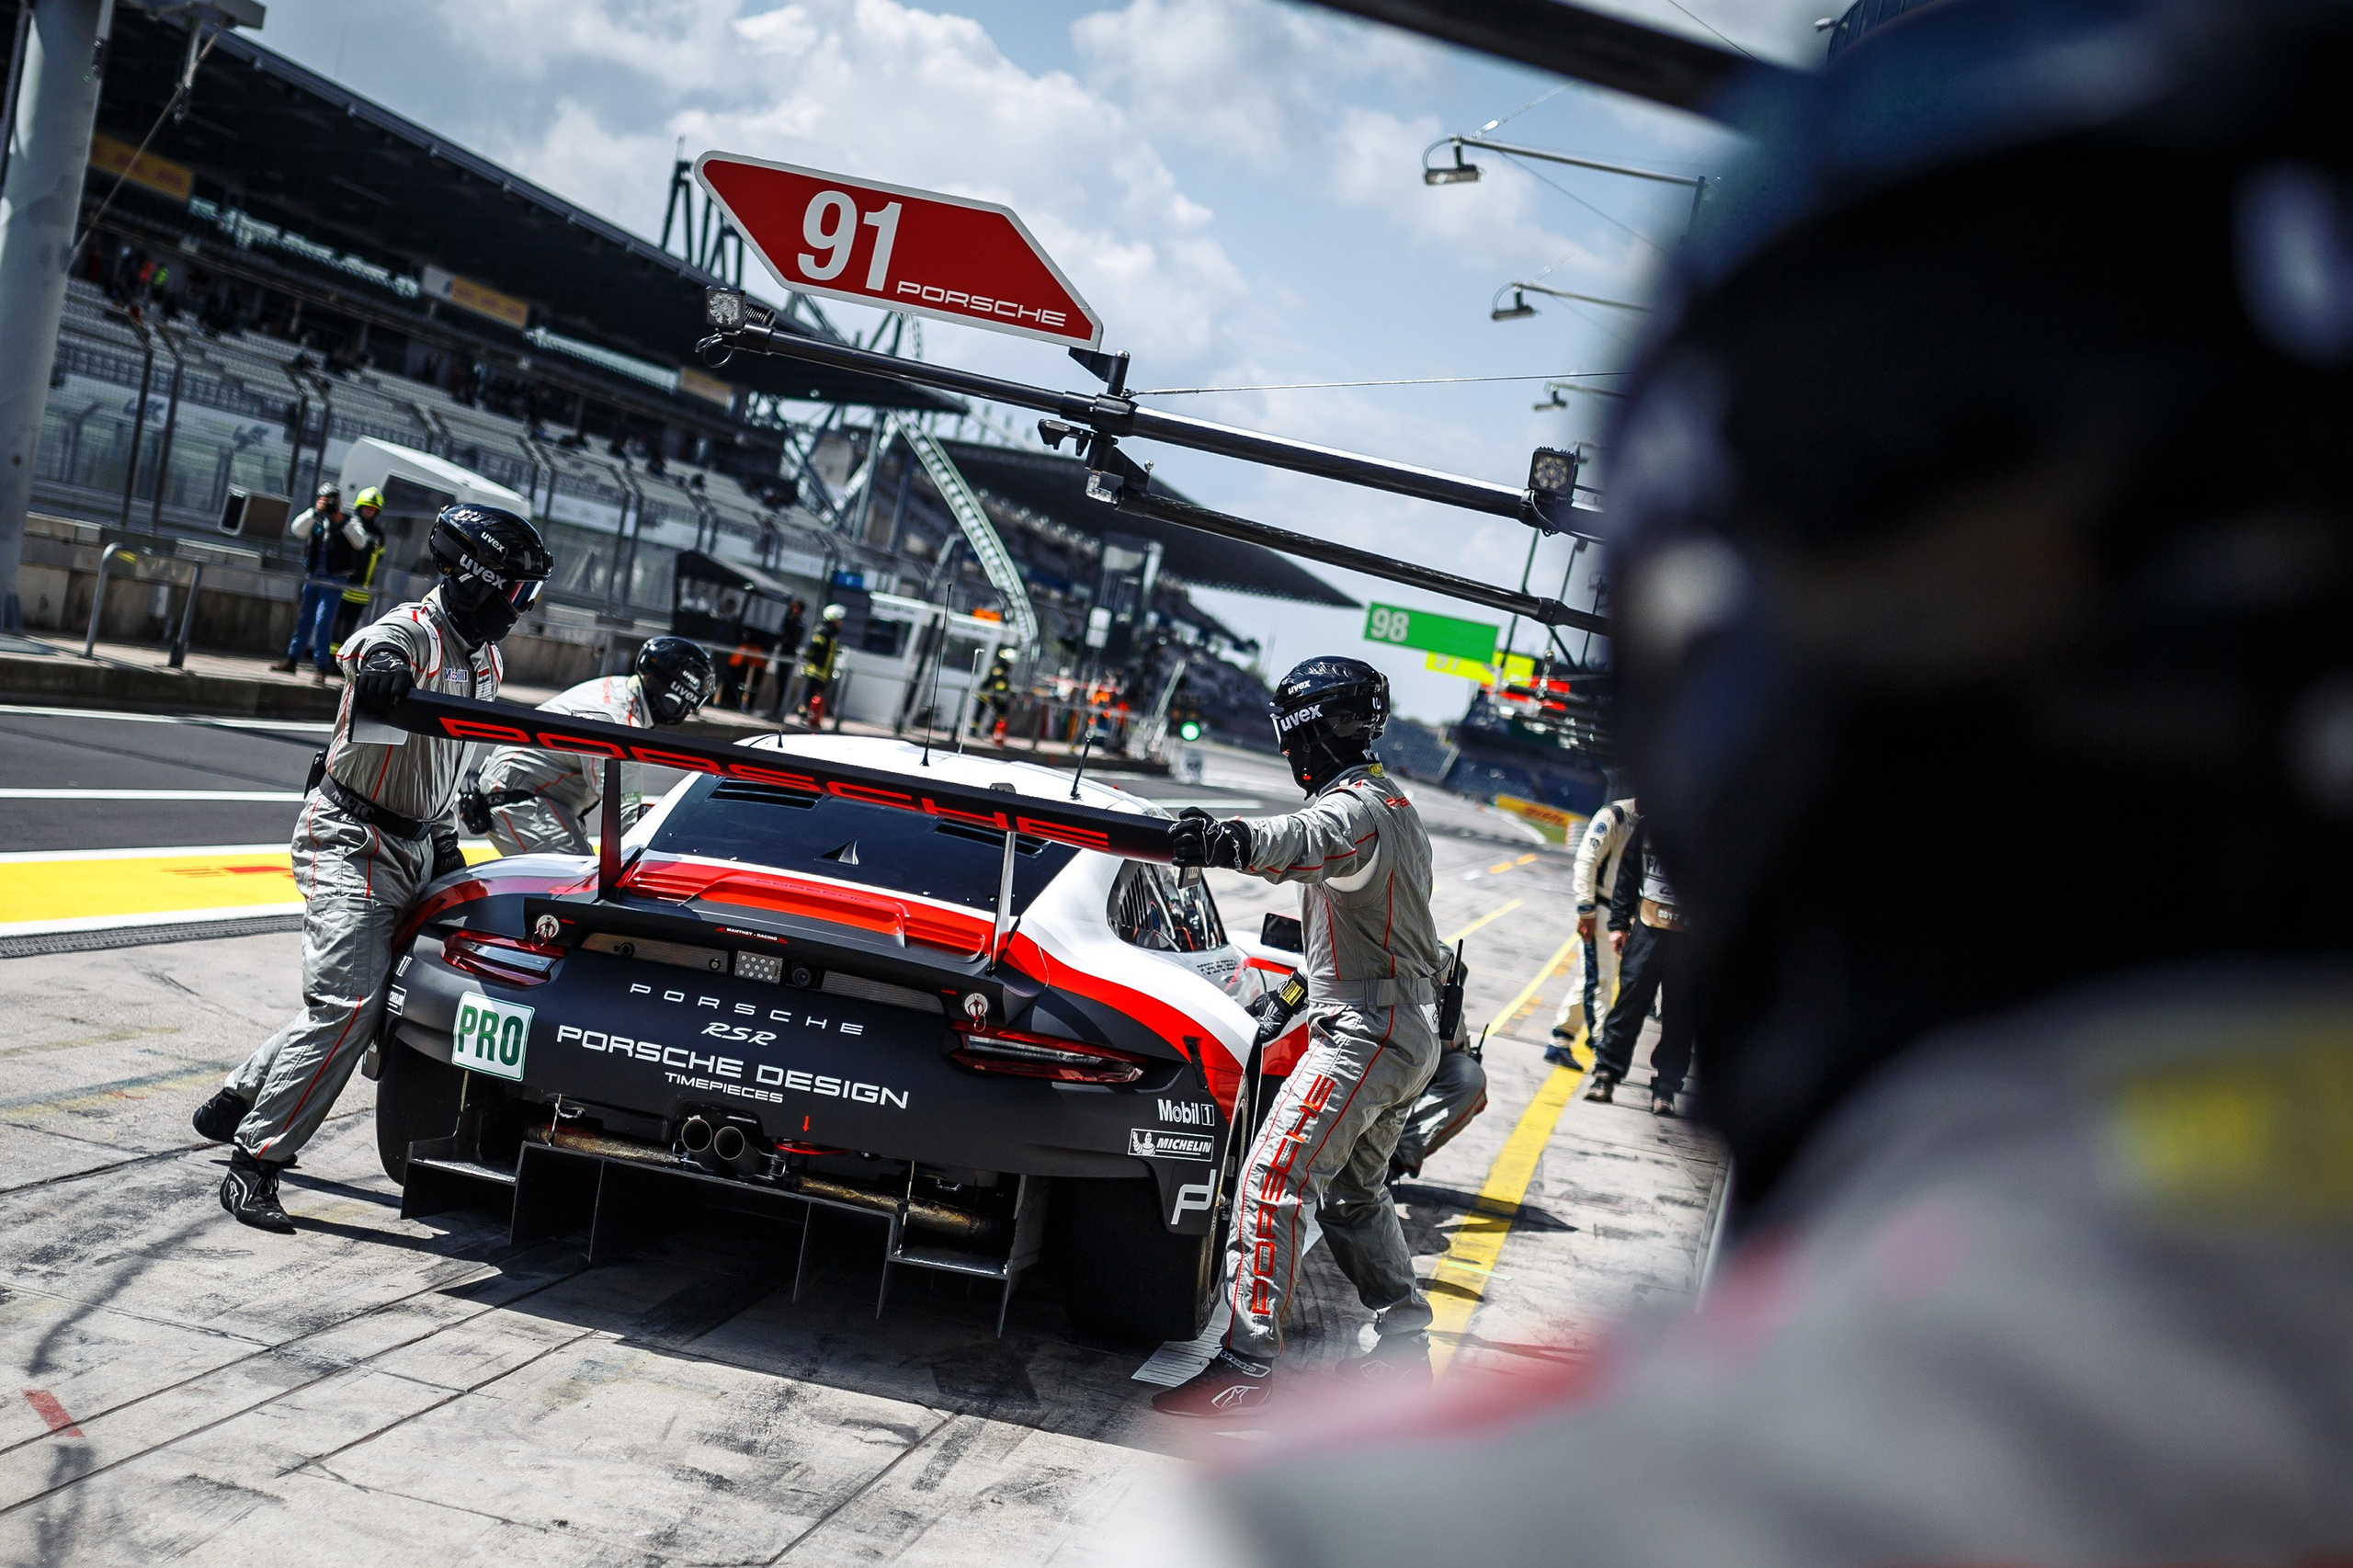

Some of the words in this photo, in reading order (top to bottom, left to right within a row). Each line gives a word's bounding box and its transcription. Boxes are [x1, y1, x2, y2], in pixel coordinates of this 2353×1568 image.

[797, 189, 903, 292] 91
[896, 280, 1067, 328] PORSCHE
[480, 531, 506, 553] uvex
[460, 553, 507, 590] uvex
[1370, 607, 1411, 643] 98
[670, 680, 700, 705] uvex
[1287, 679, 1312, 696] uvex
[1279, 703, 1324, 733] uvex
[438, 717, 1110, 852] PORSCHE
[629, 983, 864, 1036] PORSCHE
[458, 1004, 524, 1066] PRO
[700, 1021, 778, 1047] RSR
[556, 1024, 745, 1079] PORSCHE
[756, 1063, 909, 1110] DESIGN
[664, 1071, 784, 1104] TIMEPIECES
[1157, 1098, 1199, 1125] Mobil
[1155, 1137, 1212, 1153] MICHELIN
[1251, 1074, 1336, 1315] PORSCHE
